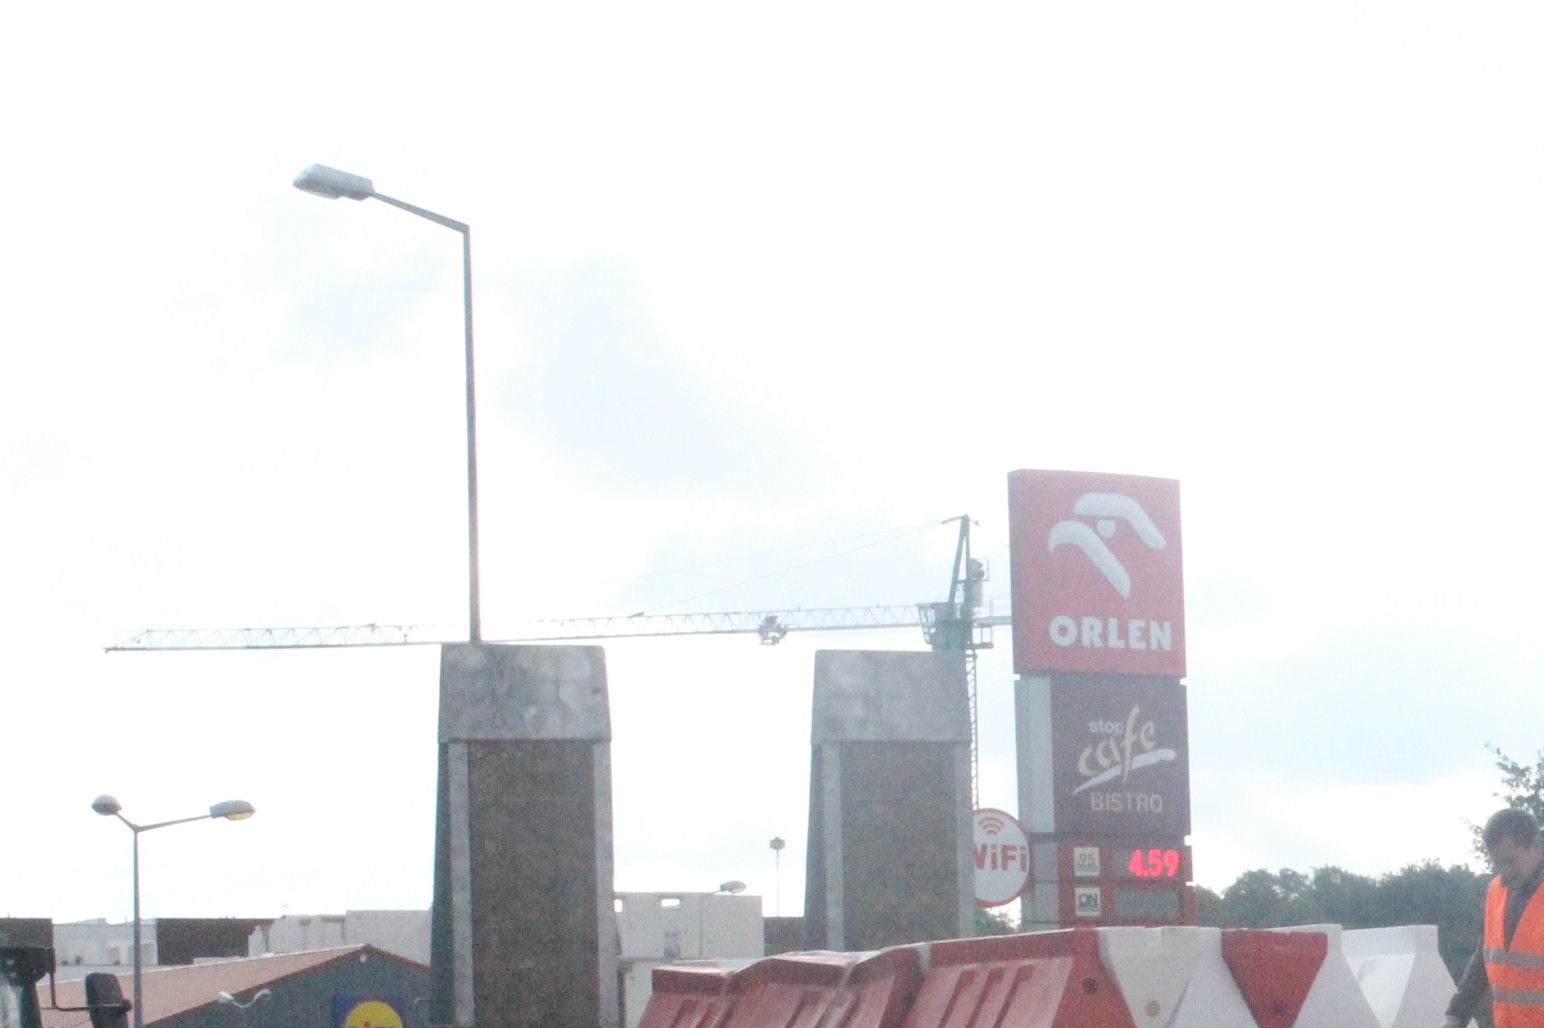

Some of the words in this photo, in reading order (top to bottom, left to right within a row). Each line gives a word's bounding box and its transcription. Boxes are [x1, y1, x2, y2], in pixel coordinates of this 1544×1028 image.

[1049, 615, 1171, 651] ORLEN
[1088, 719, 1124, 736] stop
[1091, 792, 1163, 812] BISTRO
[1128, 849, 1180, 876] 4.59
